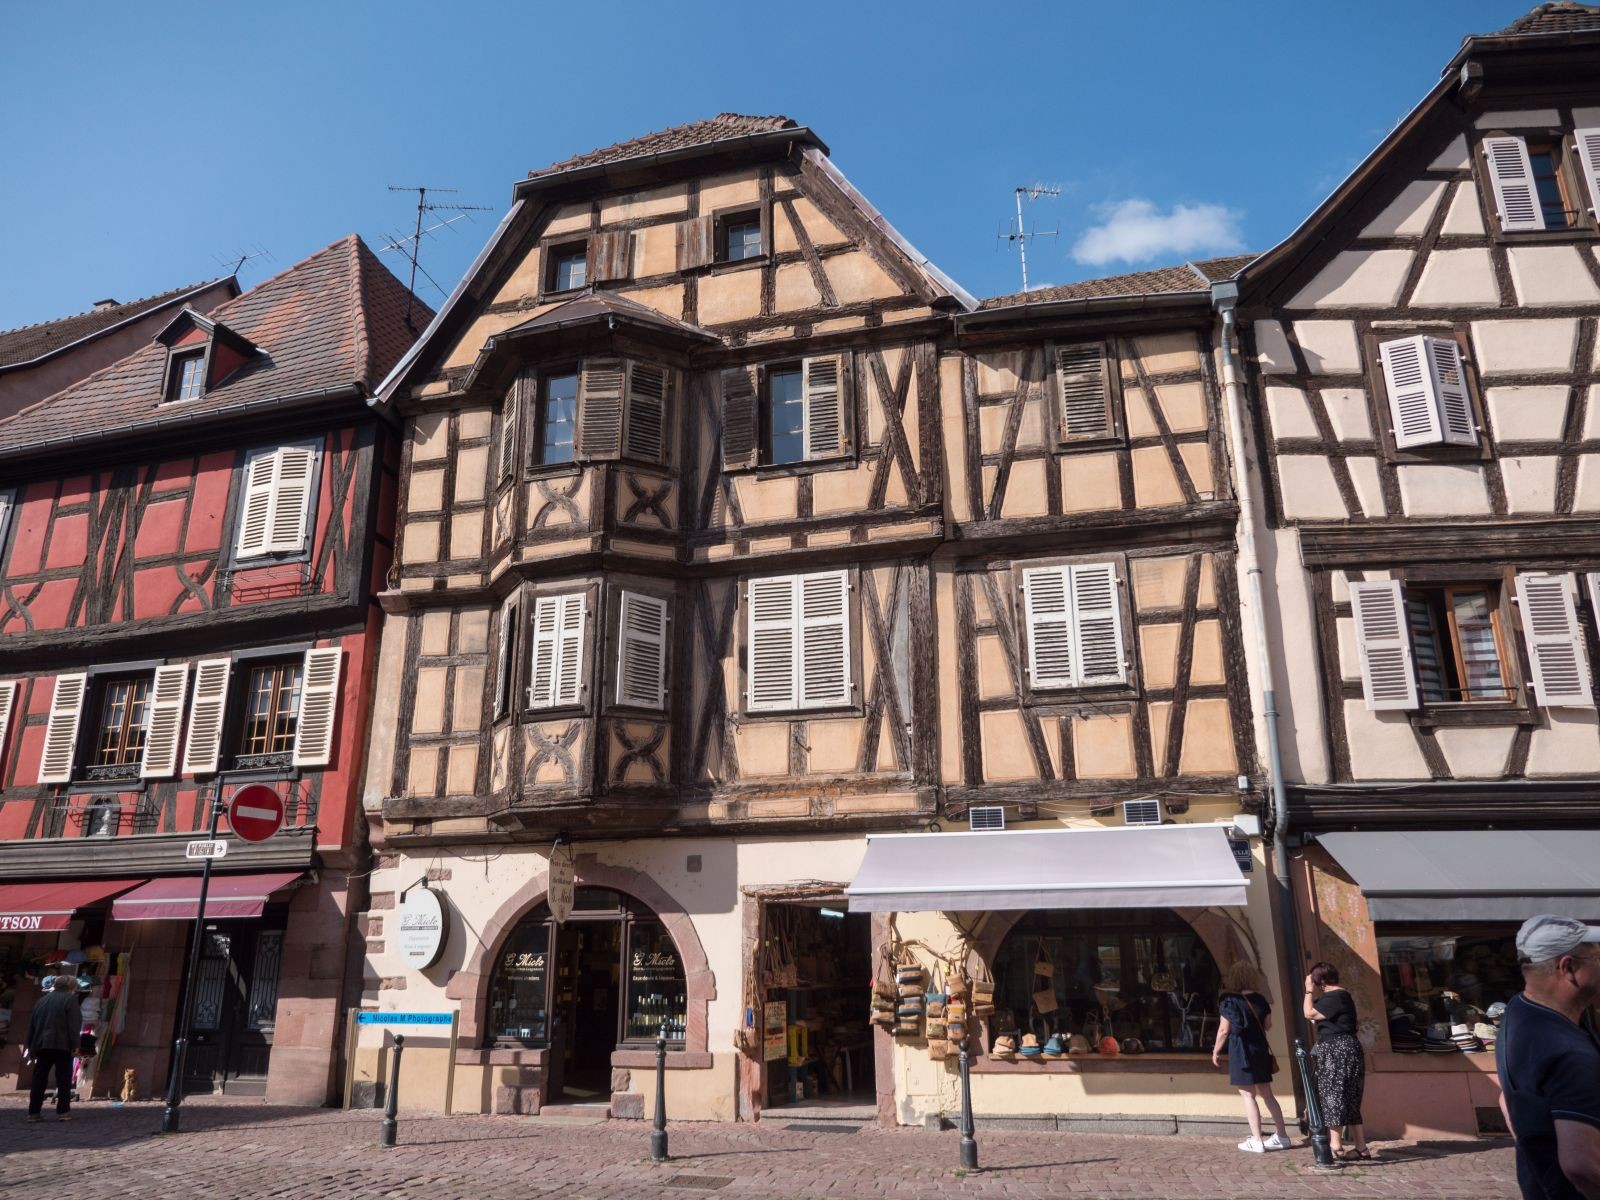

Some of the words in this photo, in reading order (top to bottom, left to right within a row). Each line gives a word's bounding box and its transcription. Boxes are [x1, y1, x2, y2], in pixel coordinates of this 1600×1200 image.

[0, 915, 42, 930] TSON
[516, 952, 545, 967] Miclo
[645, 952, 675, 966] Miclo
[372, 1014, 398, 1022] Nicolas
[407, 1014, 452, 1024] Photographe
